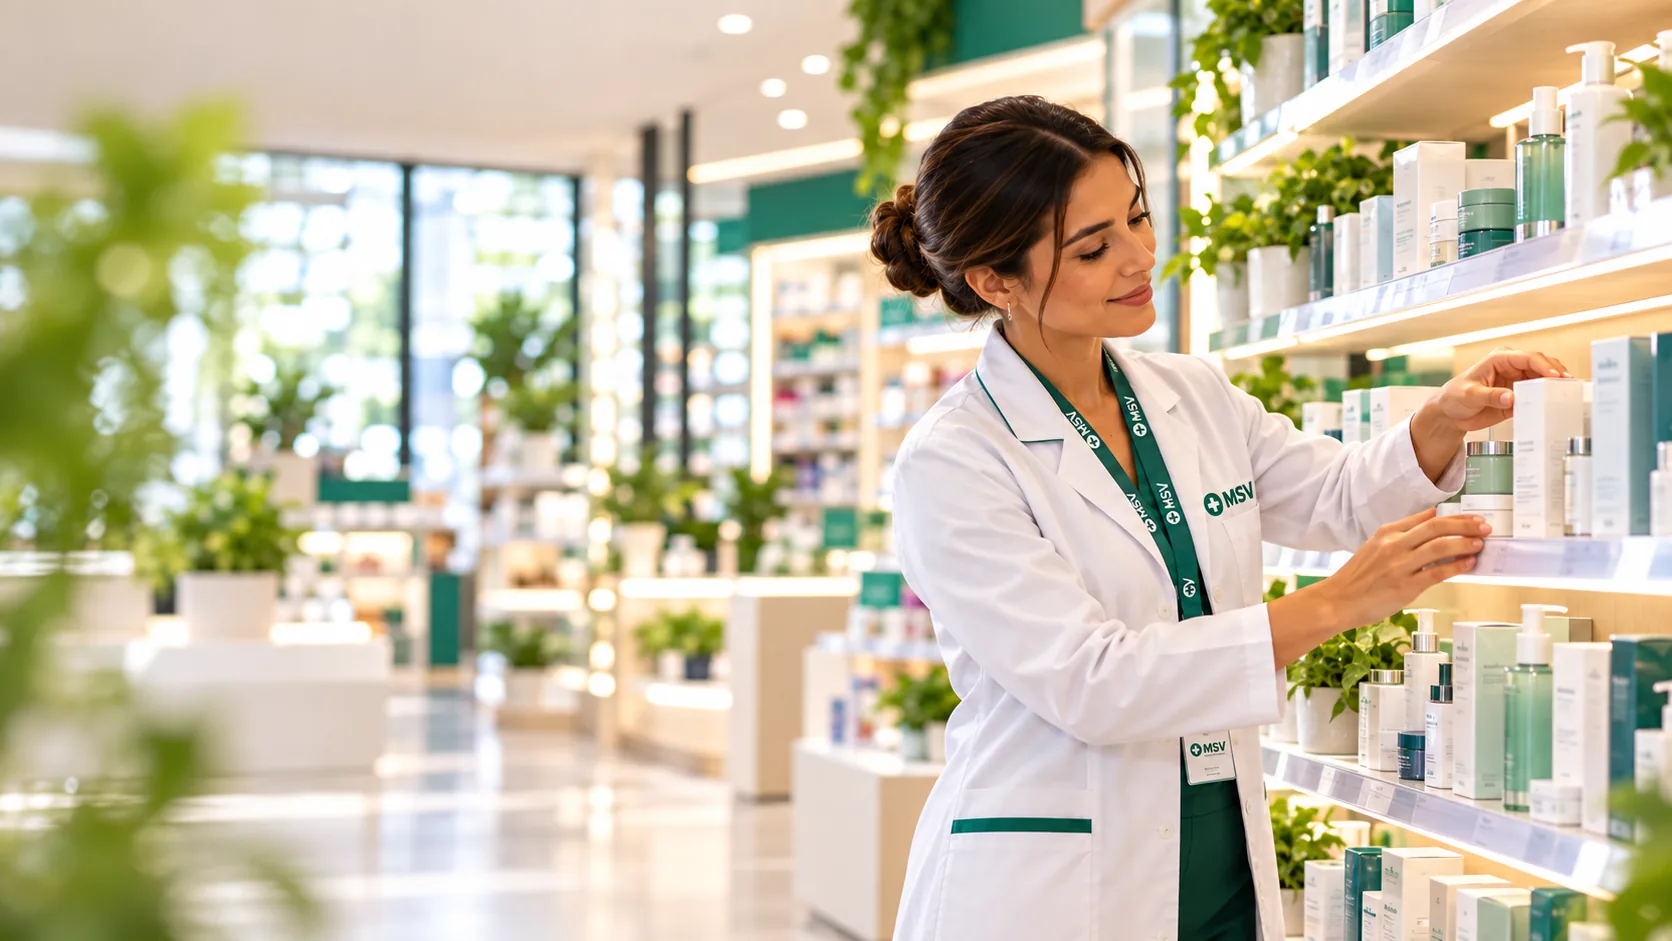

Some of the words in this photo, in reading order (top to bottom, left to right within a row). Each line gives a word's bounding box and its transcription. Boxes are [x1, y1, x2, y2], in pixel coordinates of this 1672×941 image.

[1124, 396, 1142, 421] MSV
[1066, 411, 1090, 436] MSV
[1126, 493, 1148, 520] MSV
[1156, 483, 1175, 508] MSV
[1223, 482, 1253, 507] MSV
[1203, 741, 1226, 753] MSV
